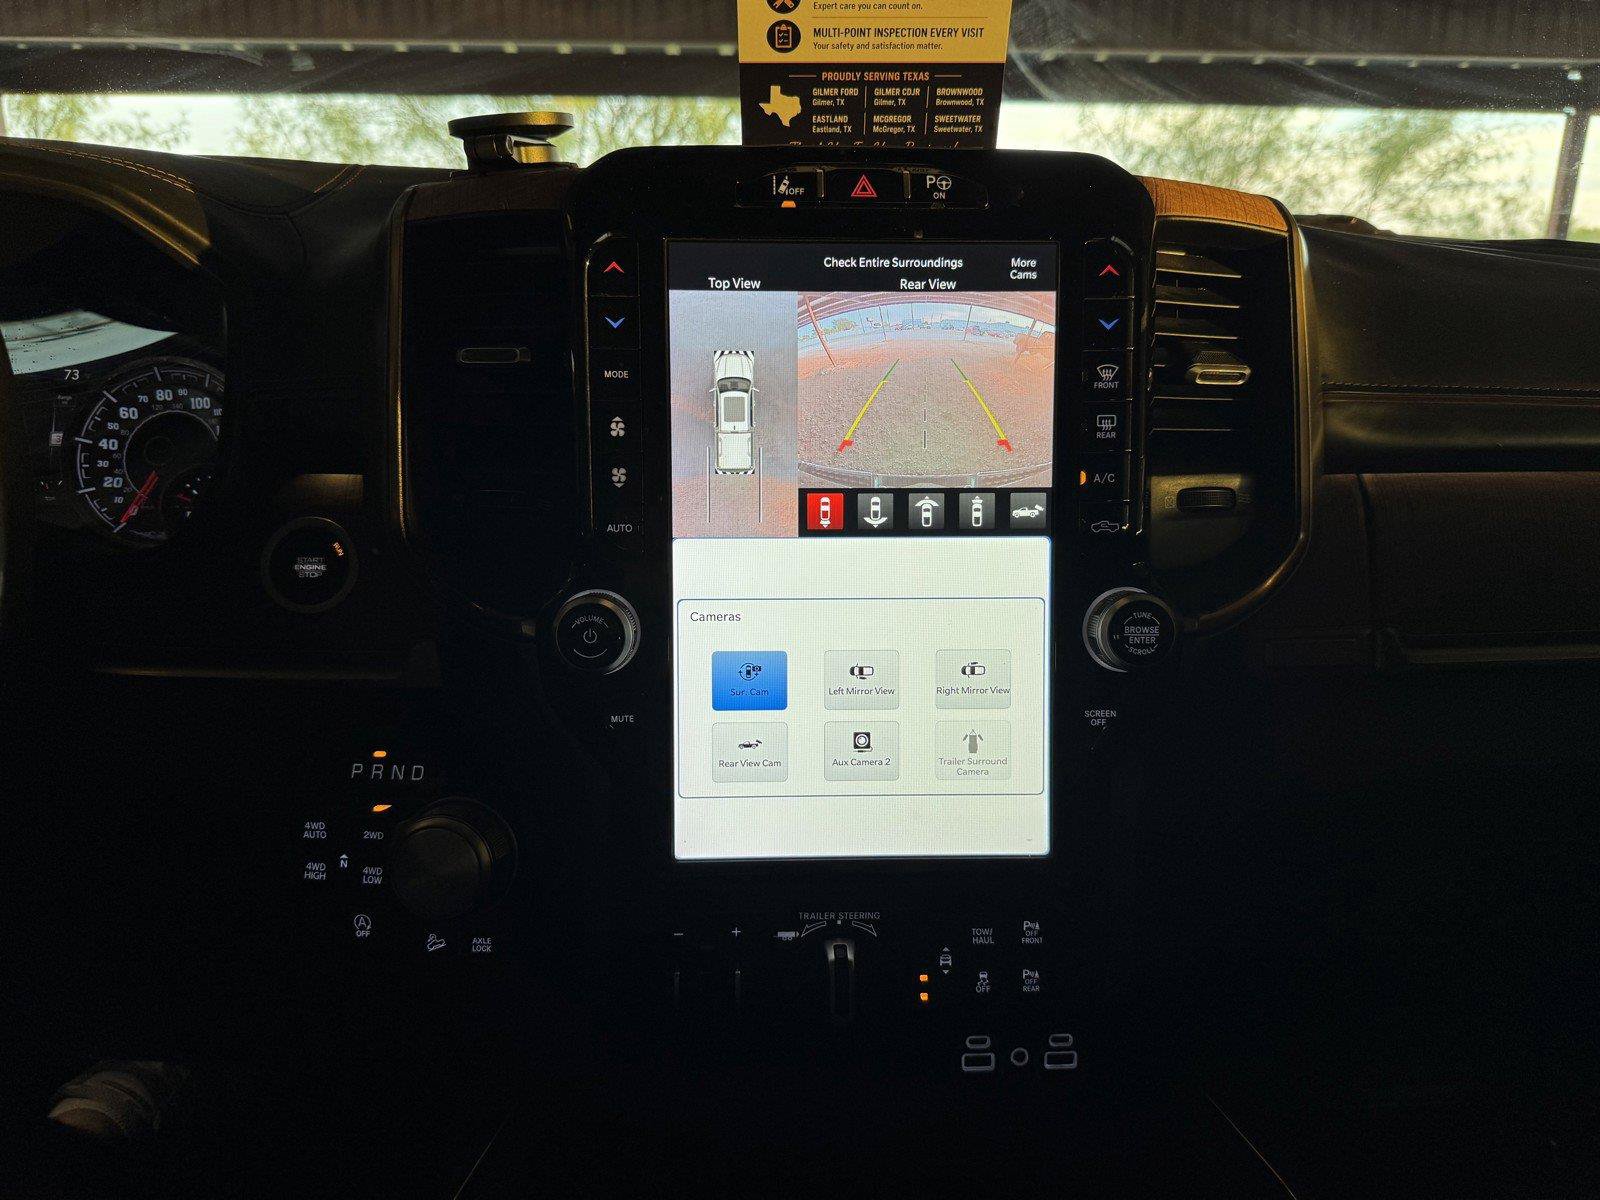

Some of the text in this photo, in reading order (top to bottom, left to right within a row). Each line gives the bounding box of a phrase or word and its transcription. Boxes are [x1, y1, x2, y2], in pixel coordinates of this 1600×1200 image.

[813, 2, 838, 12] Expert
[858, 3, 872, 12] you
[889, 2, 909, 10] count
[813, 27, 985, 38] MULTI-POINT INSPECTION EVERY VISIT
[813, 42, 830, 50] Your
[831, 42, 855, 52] safety
[856, 42, 871, 50] and
[871, 42, 915, 50] satisfaction
[821, 72, 930, 82] PROUDLY SERVING TEXAS
[812, 88, 859, 96] GILMER FORD
[874, 88, 900, 96] GILMER
[936, 88, 983, 96] BROWNWOOD
[812, 115, 848, 123] EASTLAND
[873, 115, 912, 123] MCGREGOR
[934, 115, 981, 123] SWEETWATER
[812, 126, 842, 134] Eastland,
[872, 125, 905, 135] McGregor,
[933, 126, 973, 134] Sweetwater,
[788, 187, 804, 196] OFF
[933, 191, 946, 200] ON
[823, 257, 964, 270] Check Entire Surroundings
[1011, 257, 1037, 268] More
[1010, 269, 1037, 280] Cams
[708, 277, 762, 291] Top View
[900, 278, 957, 290] Rear View
[64, 369, 80, 381] 73
[604, 370, 629, 379] MODE
[1093, 381, 1119, 389] FRONT
[155, 389, 173, 401] 80
[177, 388, 188, 396] 90
[137, 395, 149, 403] 70
[190, 397, 211, 410] 100
[119, 406, 139, 420] 60
[107, 422, 120, 430] 50
[1096, 431, 1116, 439] REAR
[98, 438, 119, 451] 40
[97, 460, 109, 468] 30
[103, 477, 123, 488] 20
[1093, 473, 1115, 483] A/C
[114, 496, 124, 504] 10
[606, 523, 633, 533] AUTO
[574, 614, 605, 625] VOLUME
[690, 611, 742, 622] Cameras
[1133, 611, 1153, 619] TUNE
[1124, 625, 1160, 634] BROWSE
[1128, 636, 1156, 644] ENTER
[1127, 646, 1156, 656] SCROLL
[730, 688, 769, 696] Sur. Cam
[828, 687, 896, 696] Left Mirror View
[936, 686, 1011, 697] Right Mirror View
[1084, 709, 1117, 717] SCREEN
[610, 715, 635, 723] MUTE
[1090, 718, 1107, 726] OFF
[718, 759, 782, 768] Rear View Cam
[832, 757, 892, 767] Aux Camera 2
[938, 757, 1008, 766] Trailer Surround
[351, 763, 425, 781] P R N D
[956, 767, 990, 776] Camera
[304, 821, 326, 830] 4WD
[302, 830, 327, 839] AUTO
[363, 830, 384, 840] 2WD
[306, 862, 327, 871] 4WD
[340, 859, 348, 868] N
[304, 871, 327, 880] HIGH
[362, 866, 383, 876] 4WD
[362, 875, 383, 885] LOW
[799, 911, 880, 920] TRAILER STEERING
[355, 930, 371, 938] OFF
[971, 928, 993, 936] TOW/
[472, 937, 492, 945] AXLE
[972, 936, 995, 945] HAUL
[975, 986, 991, 994] OFF
